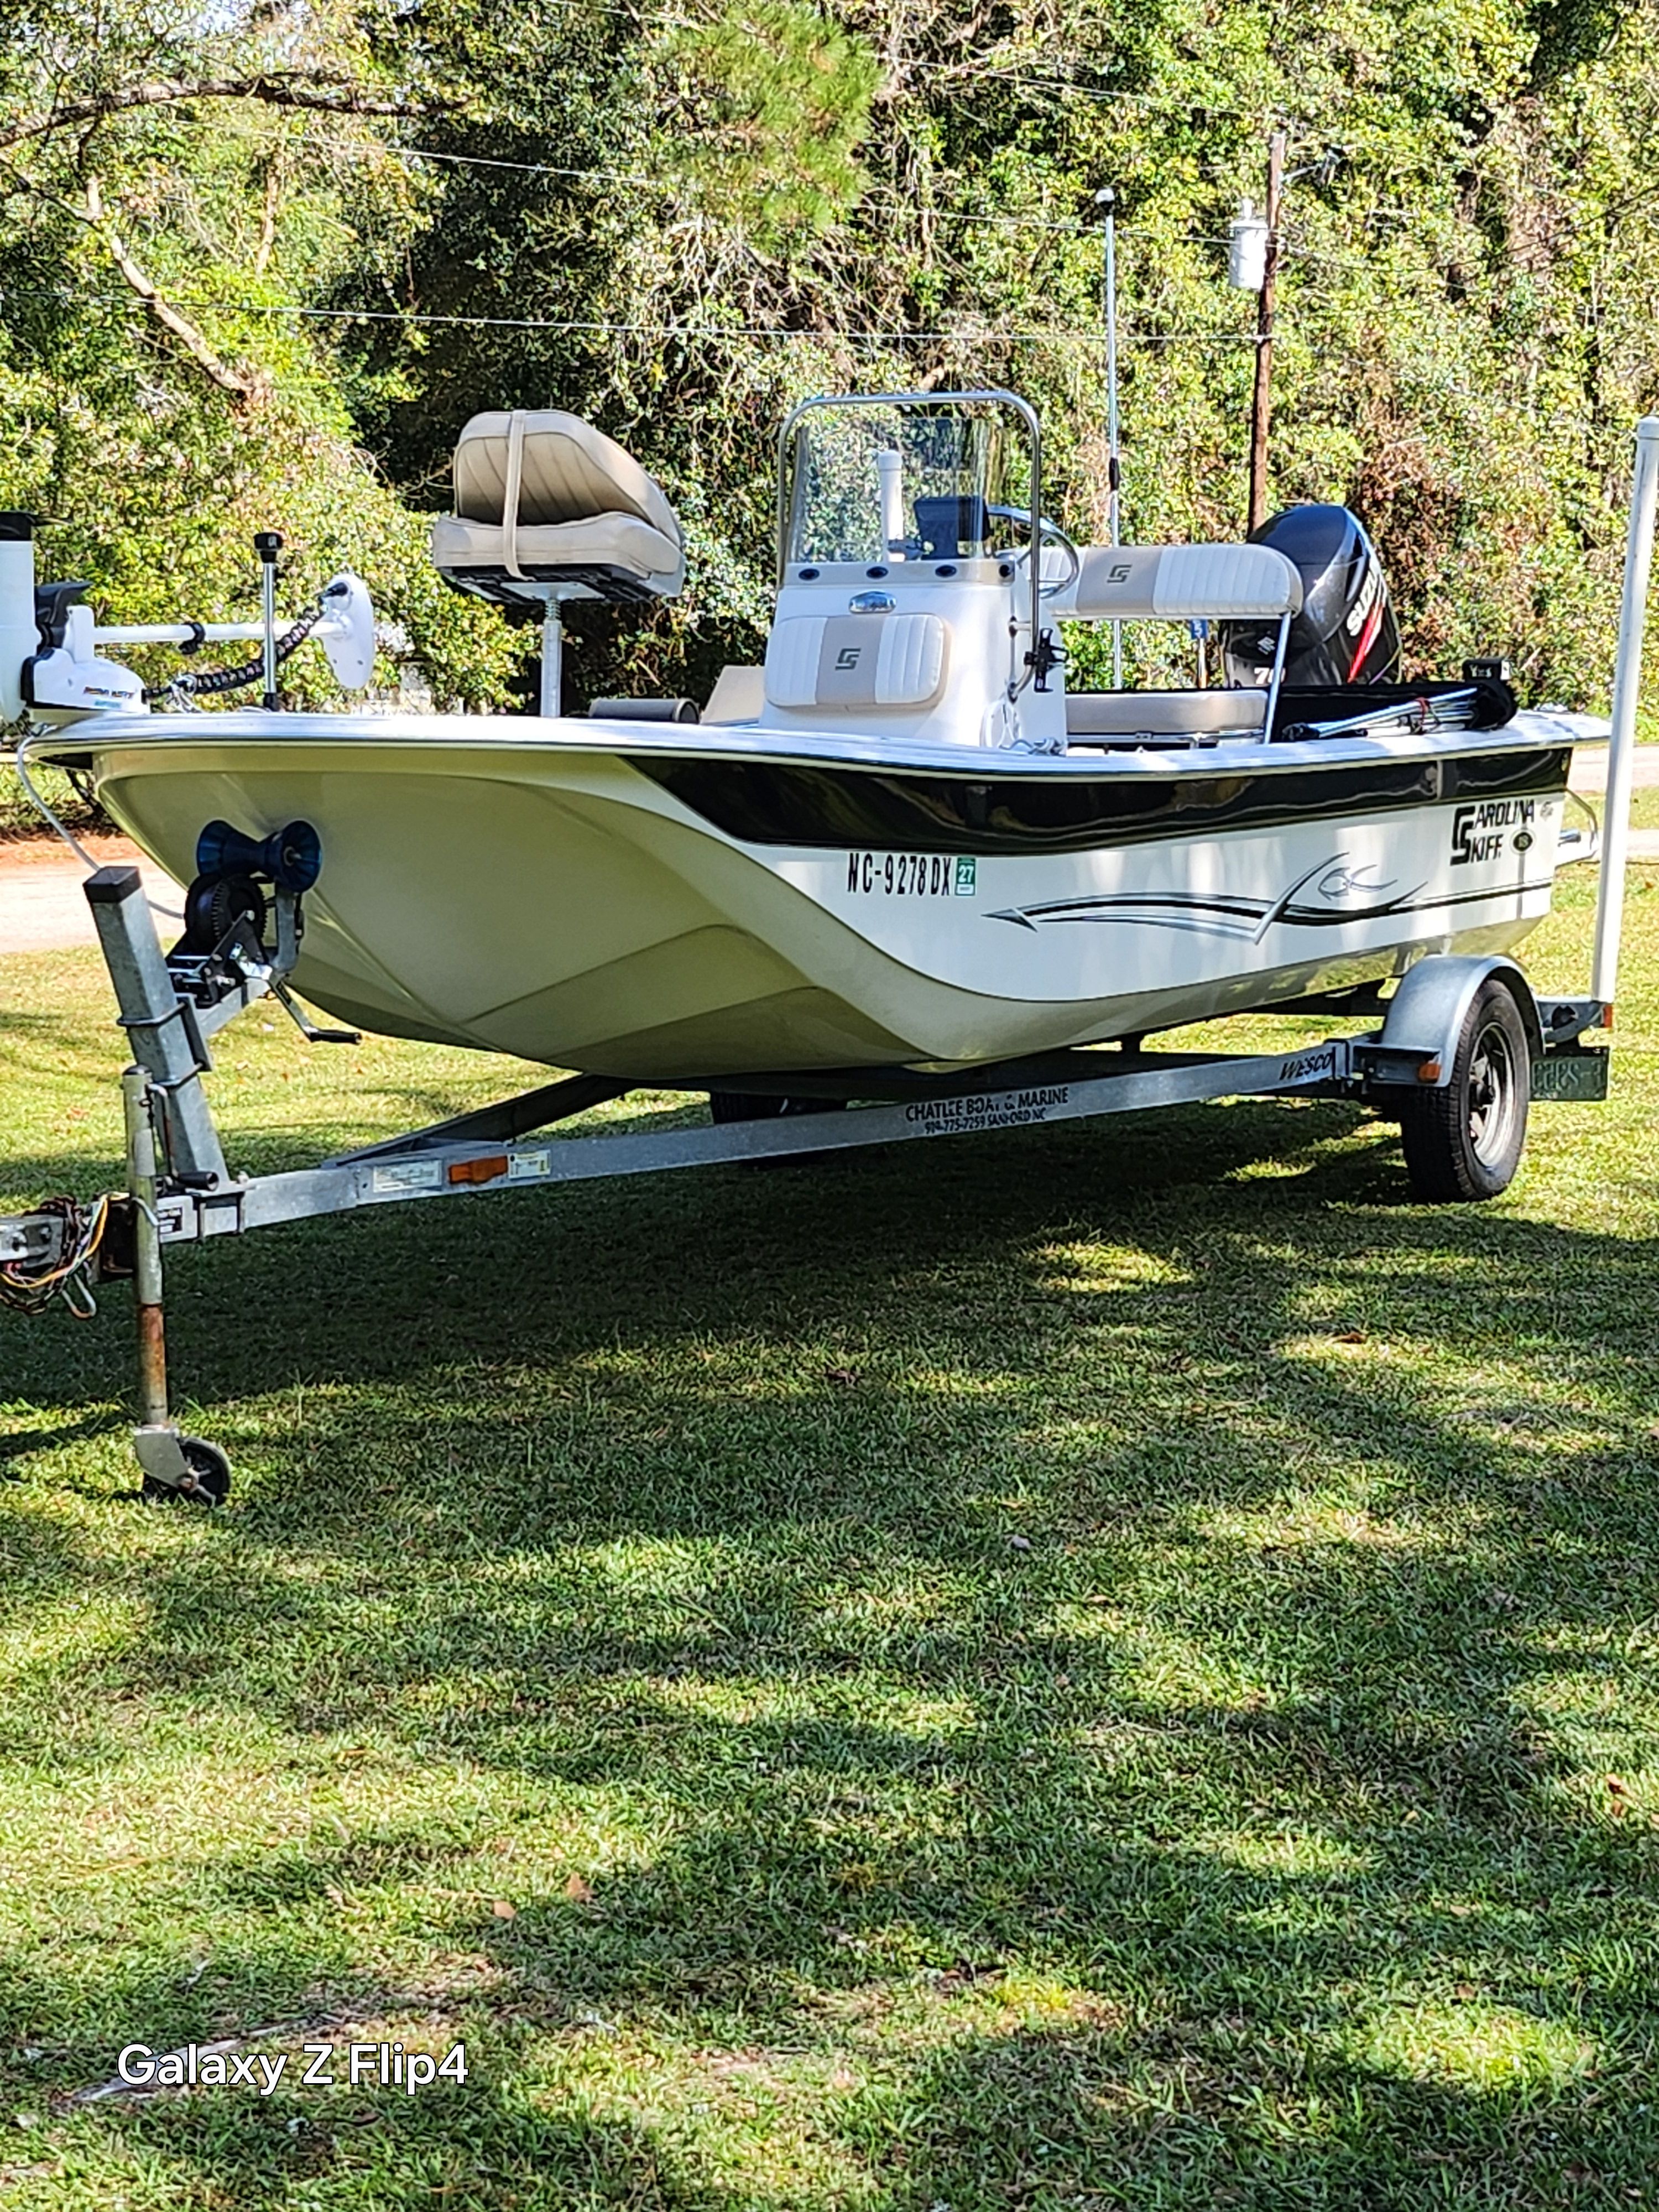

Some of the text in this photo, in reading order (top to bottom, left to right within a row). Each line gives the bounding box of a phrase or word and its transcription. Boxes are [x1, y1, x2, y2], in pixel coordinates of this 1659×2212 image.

[958, 864, 974, 883] 27
[1279, 1052, 1333, 1080] WESCO
[905, 1099, 963, 1123] CHATLEE
[1018, 1086, 1068, 1109] MARINE
